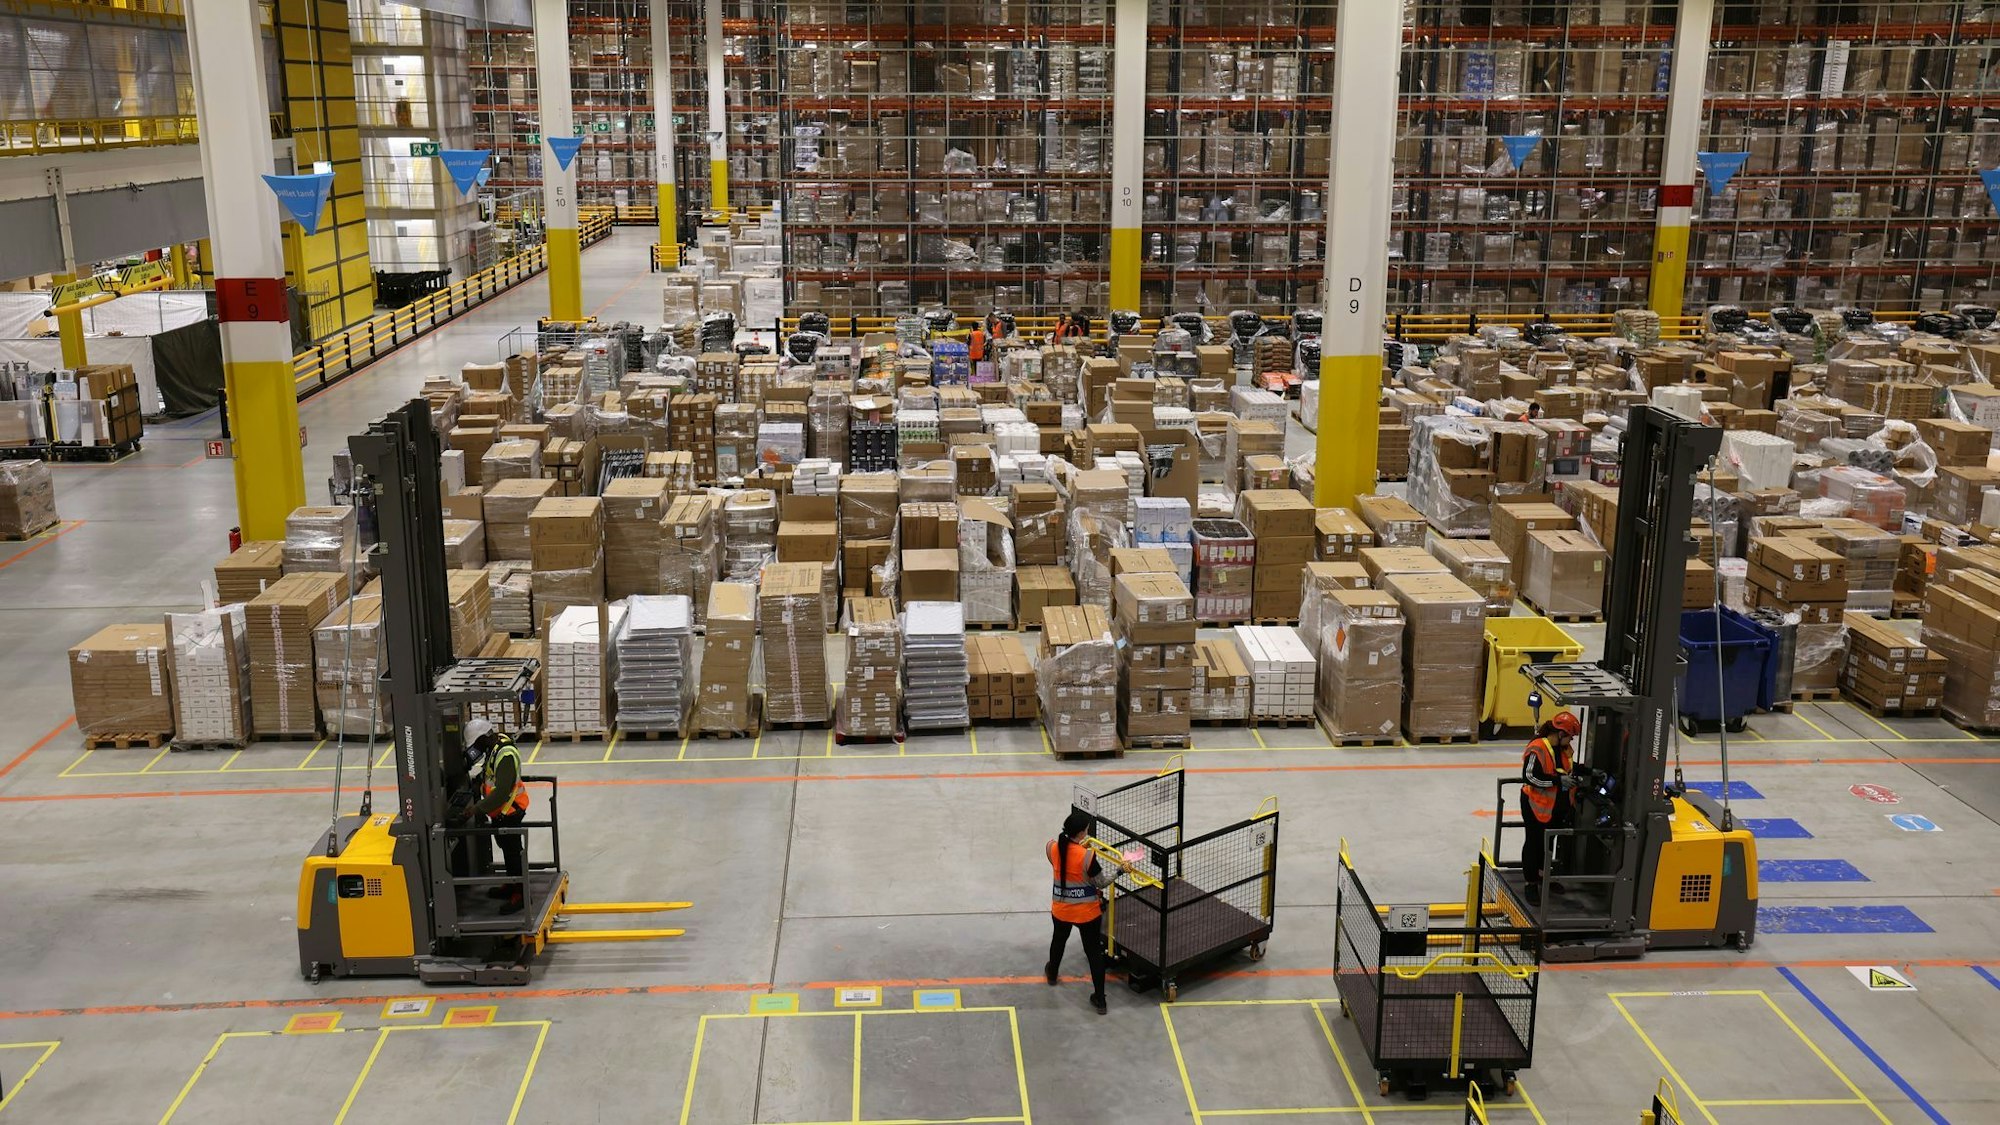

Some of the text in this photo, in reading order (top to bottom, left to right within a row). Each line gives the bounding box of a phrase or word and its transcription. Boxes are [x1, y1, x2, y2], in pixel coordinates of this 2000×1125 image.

[556, 187, 564, 196] E
[1123, 187, 1131, 196] D
[555, 198, 566, 207] 10
[1122, 198, 1132, 207] 10
[245, 281, 257, 297] E
[1349, 277, 1362, 292] D
[248, 303, 259, 319] 9
[1349, 299, 1359, 314] 9
[1652, 708, 1663, 760] JUNGHEINRICH
[404, 725, 416, 781] JUNGHEINRICH
